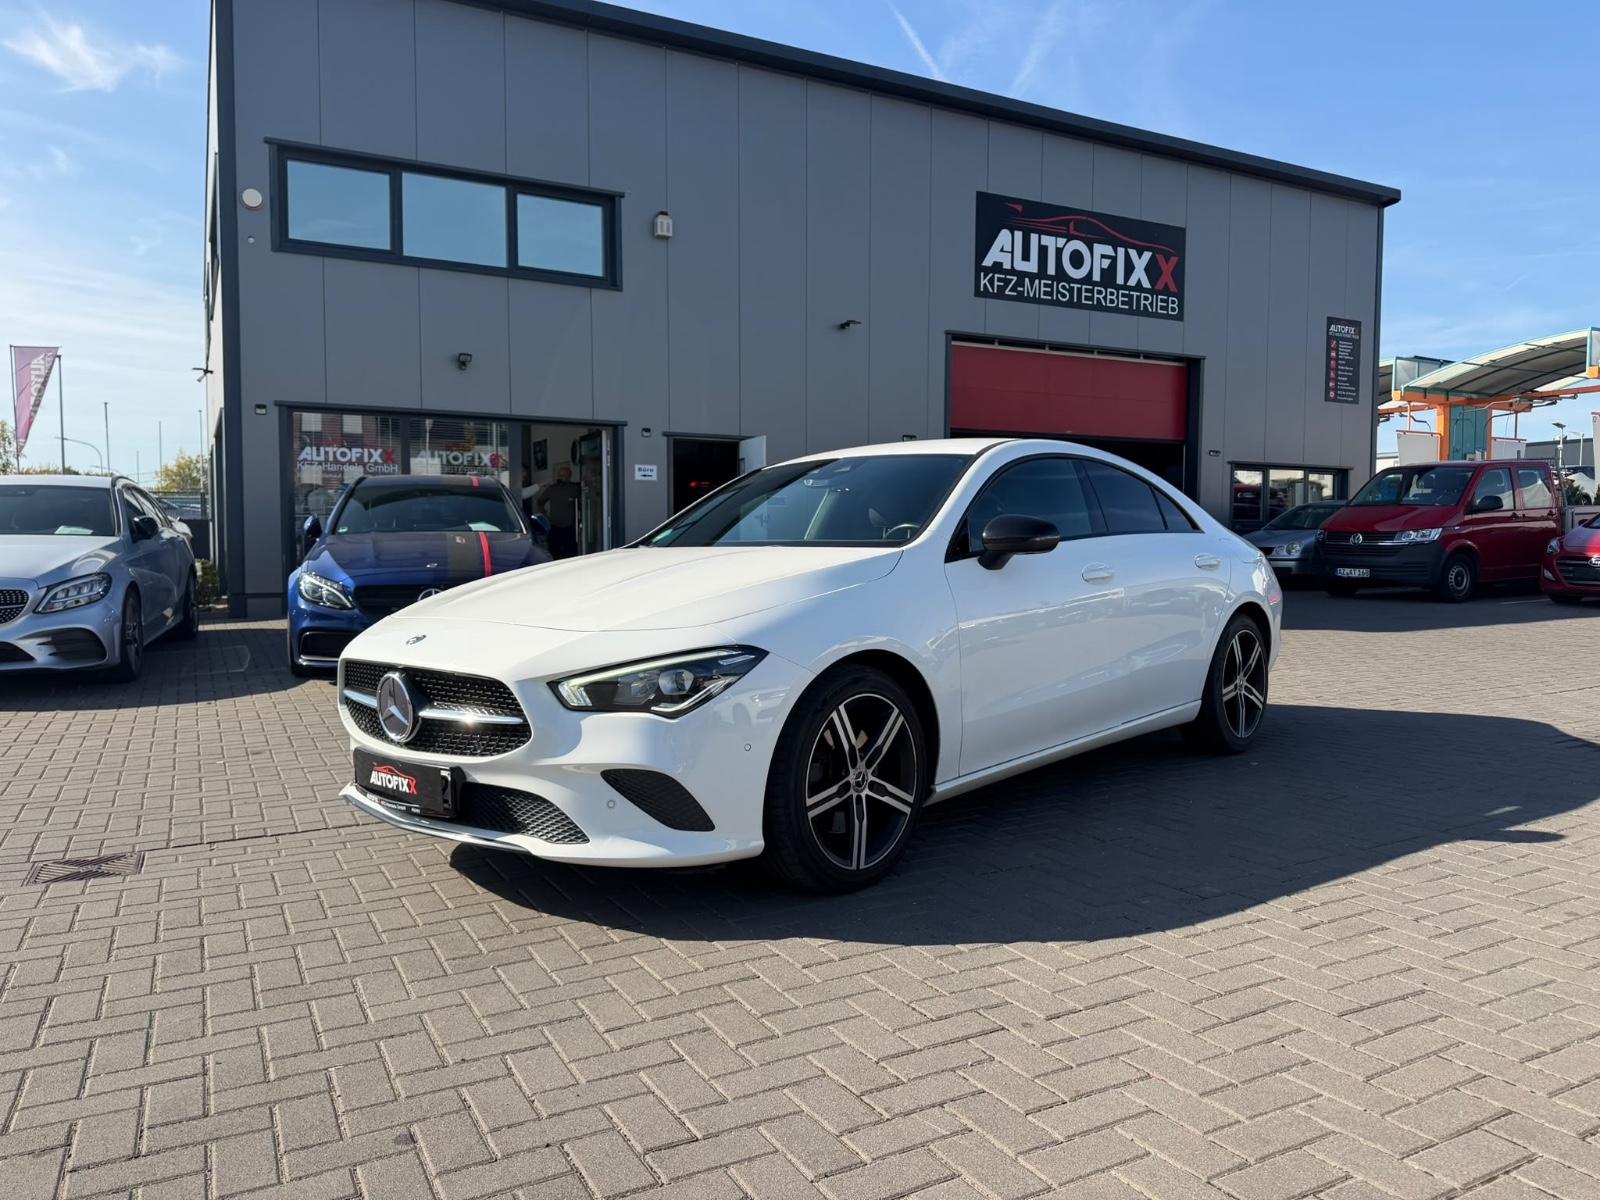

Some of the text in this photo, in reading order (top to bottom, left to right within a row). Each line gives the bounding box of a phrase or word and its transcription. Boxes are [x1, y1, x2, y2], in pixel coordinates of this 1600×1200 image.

[981, 228, 1180, 292] AUTOFIXX
[980, 272, 1179, 315] KFZ-MEISTERBETRIEB
[366, 463, 398, 473] GmbH
[370, 770, 417, 794] AUTOFIXX
